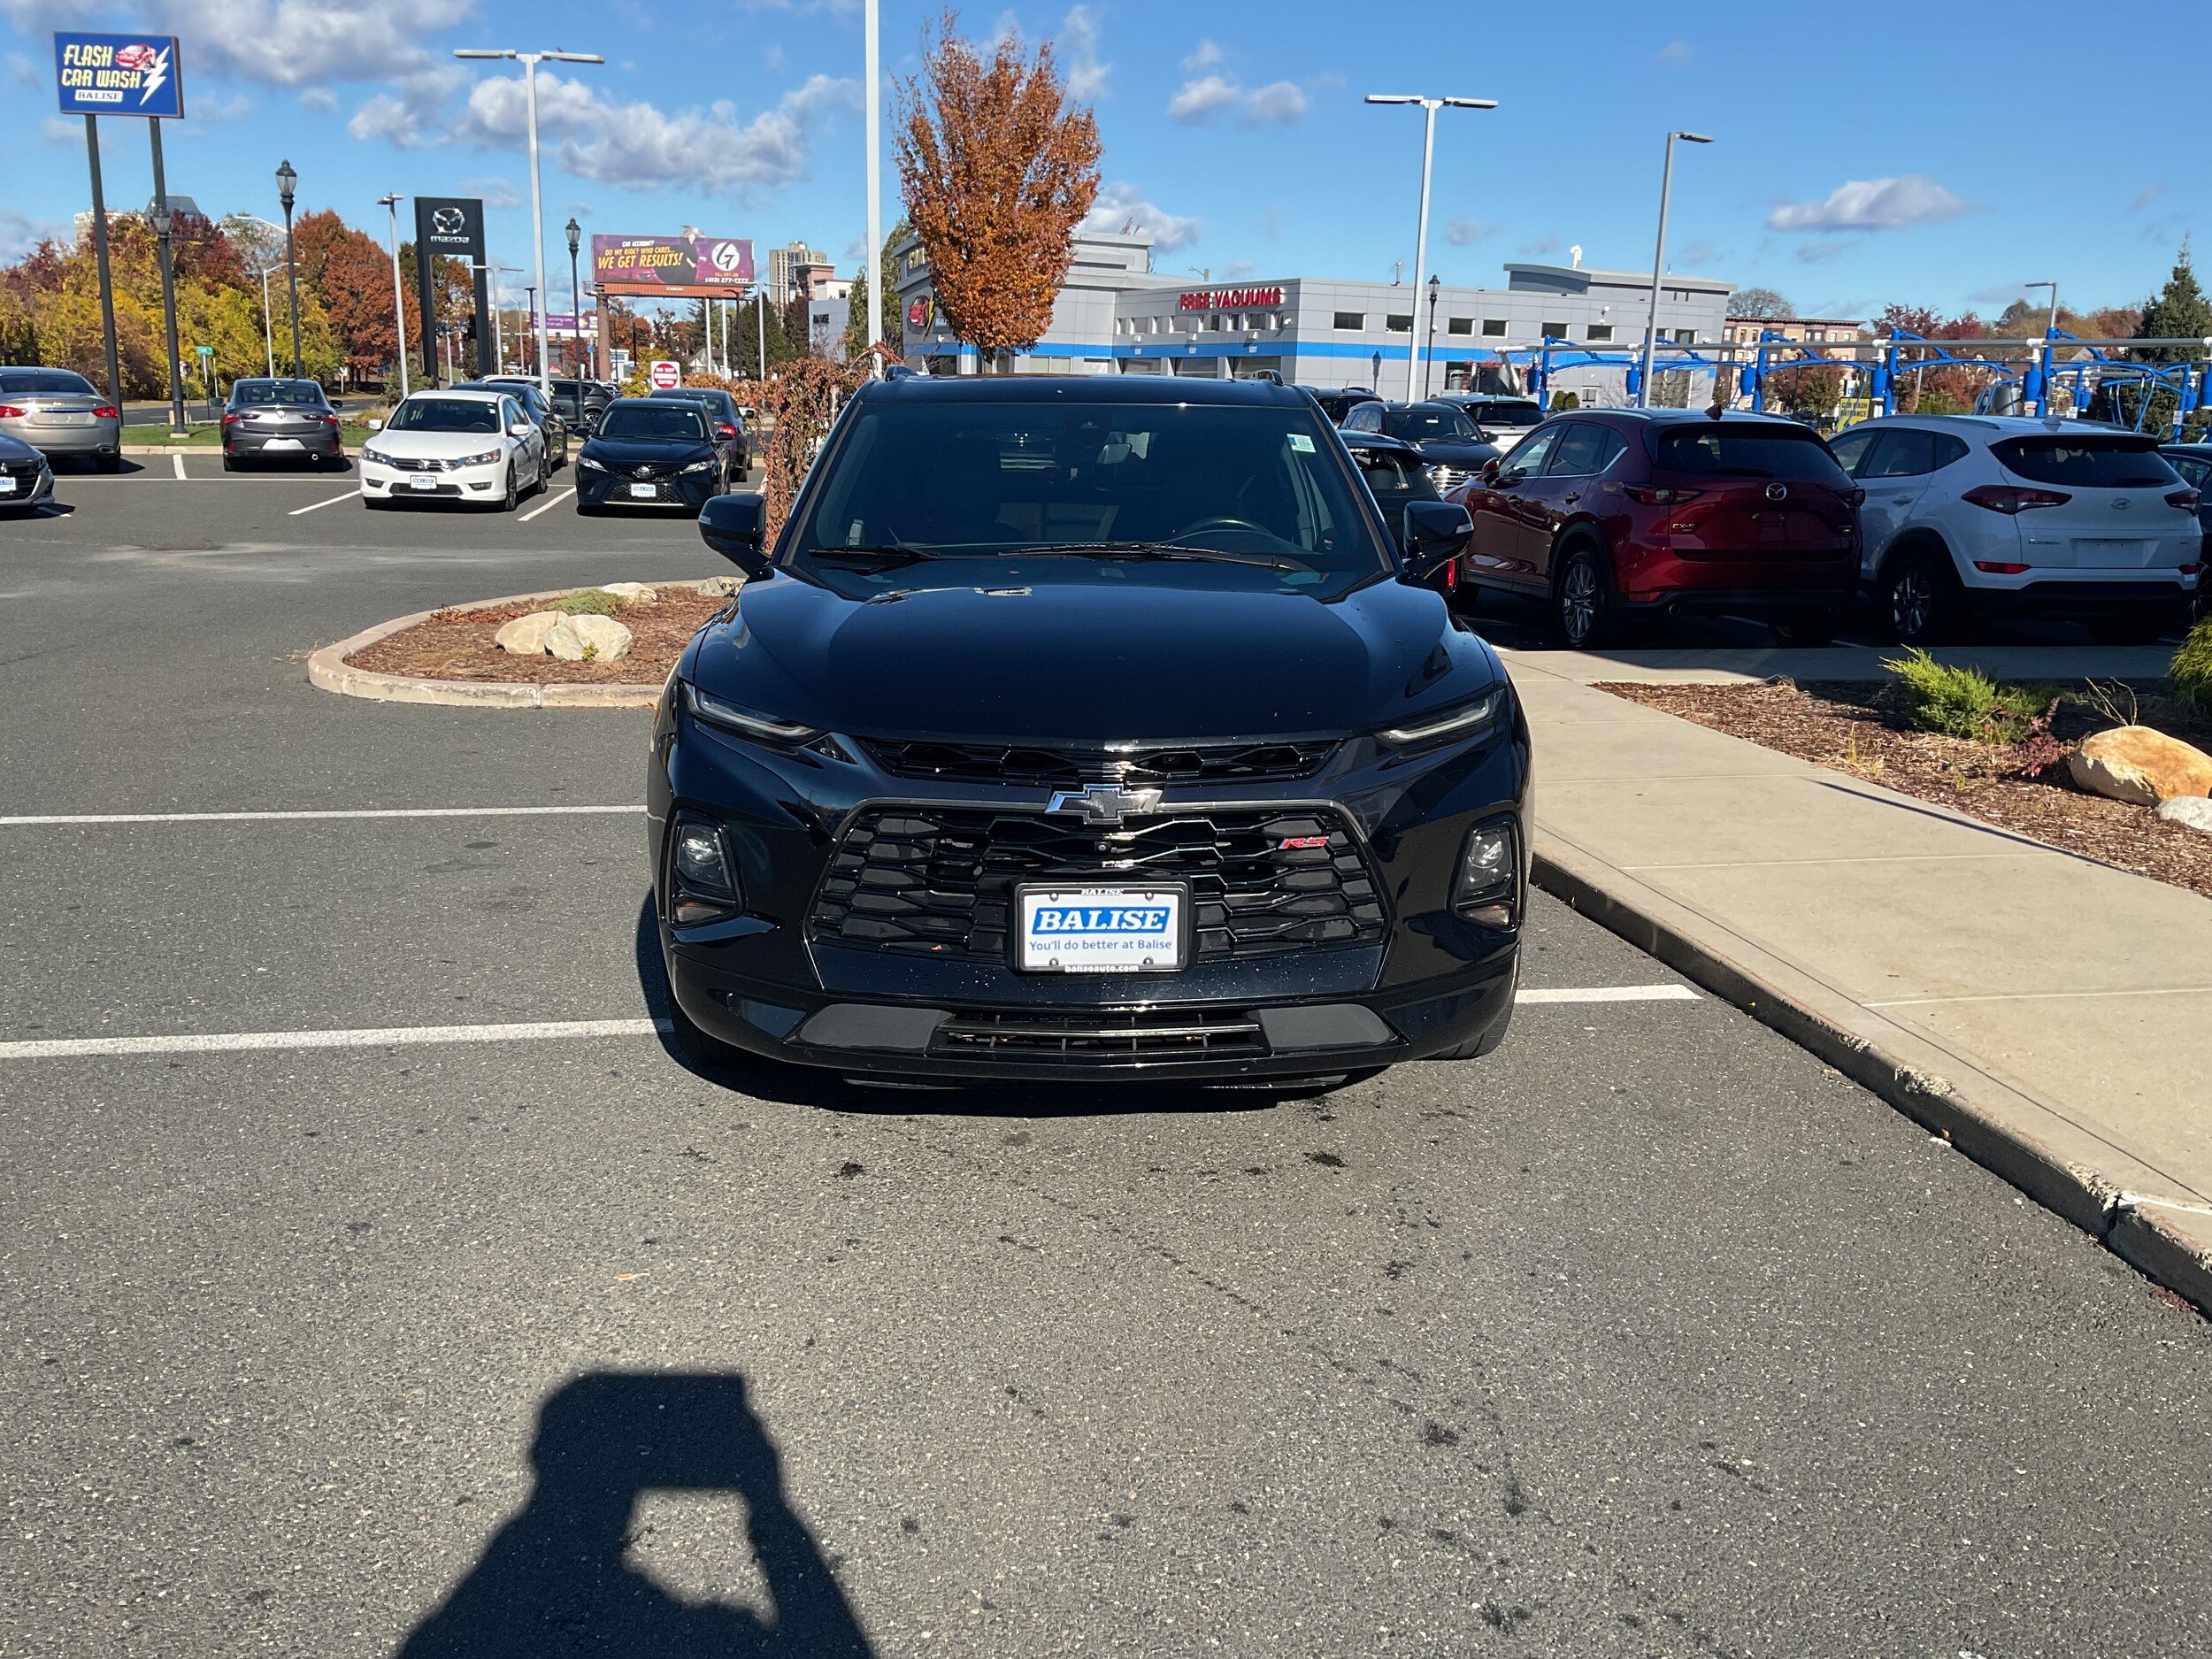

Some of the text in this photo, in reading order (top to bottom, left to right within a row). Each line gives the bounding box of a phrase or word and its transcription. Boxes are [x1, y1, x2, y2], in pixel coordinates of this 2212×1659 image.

[64, 44, 113, 67] FLASH
[61, 68, 142, 88] CAR WASH
[78, 91, 120, 100] BALISE
[598, 252, 684, 269] WE GET RESULTS!
[1179, 288, 1286, 310] FREE VACUUMS
[1278, 836, 1330, 849] RS
[1036, 910, 1166, 932] BALISE
[1029, 939, 1172, 951] You'll do better at Balise
[1064, 964, 1139, 973] baliseauto.com
